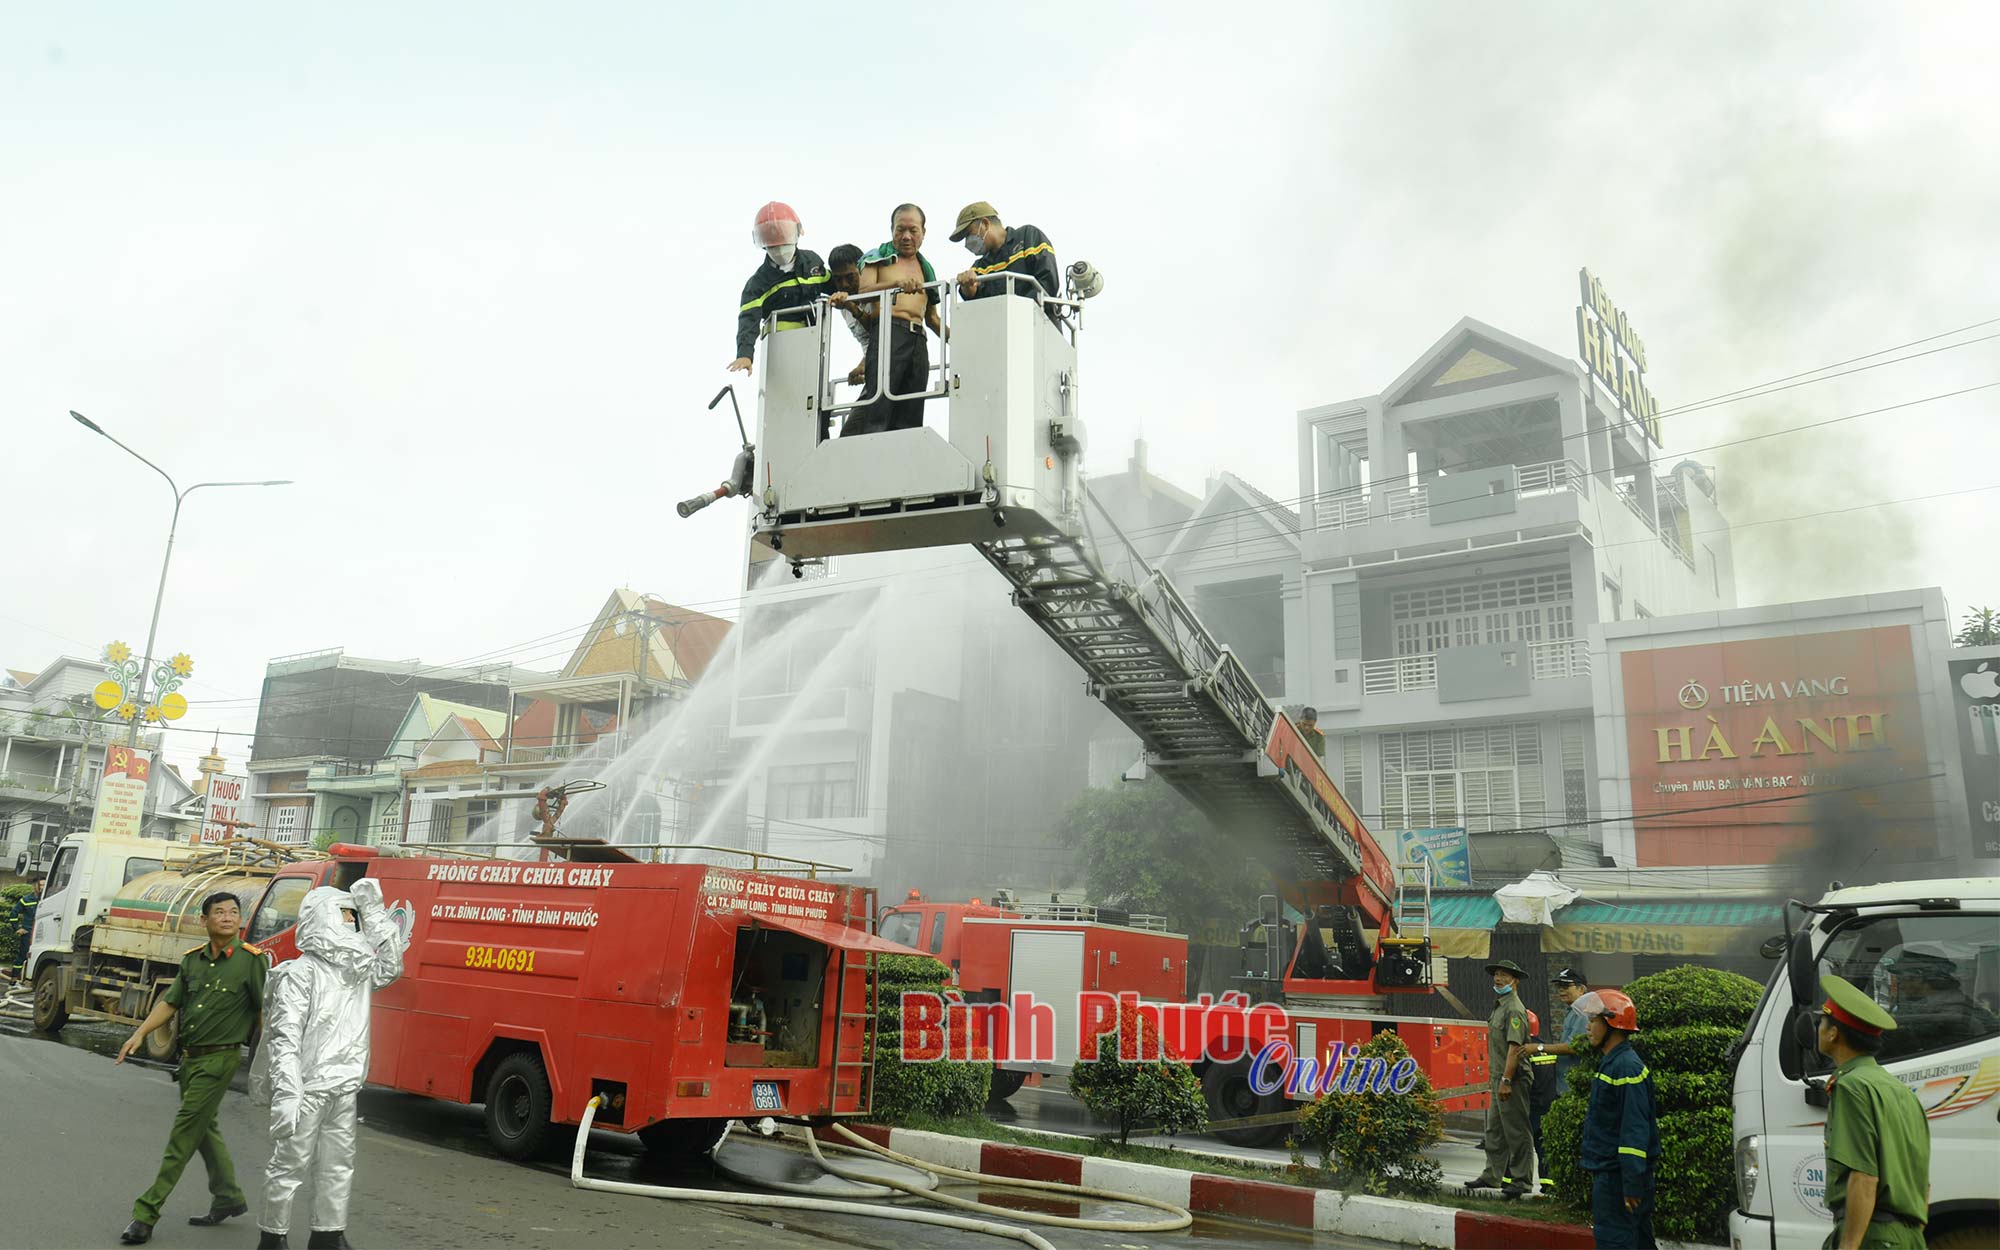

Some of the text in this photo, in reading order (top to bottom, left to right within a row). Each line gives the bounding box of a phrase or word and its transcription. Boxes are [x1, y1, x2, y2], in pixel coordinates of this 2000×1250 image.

[1720, 680, 1776, 706] TIỆM
[1653, 712, 1893, 764] HÀ ANH
[1693, 780, 1716, 792] MUA
[427, 861, 614, 887] PHÒNG CHÁY CHỮA CHÁY
[707, 895, 717, 907] CA
[749, 901, 767, 912] LONG
[747, 881, 776, 897] CHÁY
[808, 888, 835, 904] CHÁY
[431, 904, 443, 917] CA
[480, 907, 507, 922] LONG
[511, 904, 535, 924] TỈNH
[535, 906, 560, 925] BÌNH
[562, 906, 599, 927] PHƯỚC
[1628, 928, 1684, 951] VÀNG
[465, 946, 536, 972] 93A-0691
[756, 1084, 774, 1097] 93A
[756, 1096, 778, 1108] 0691
